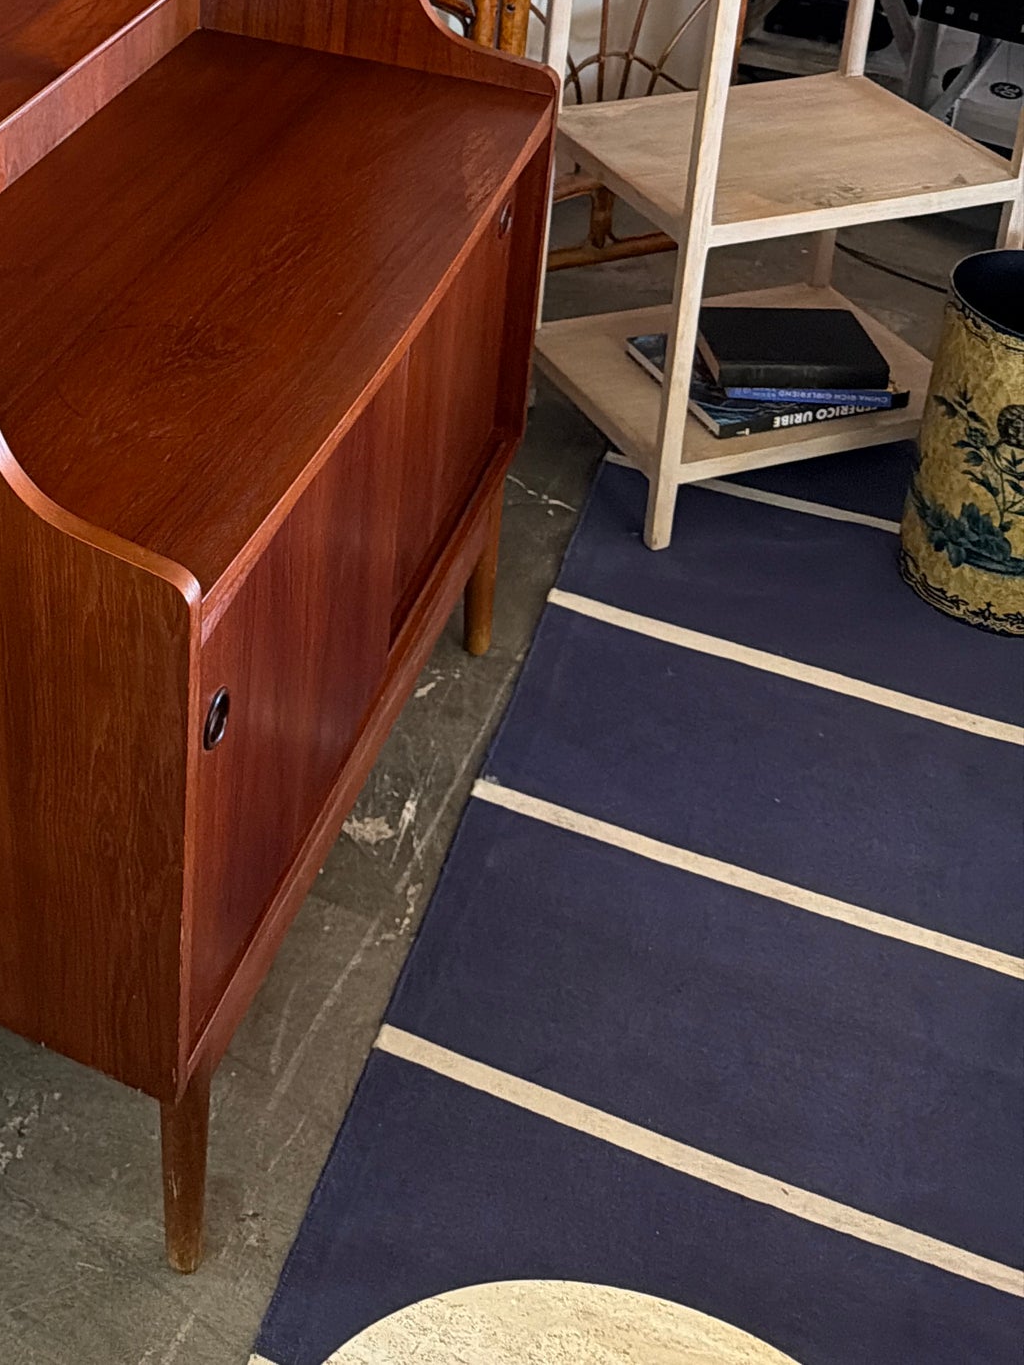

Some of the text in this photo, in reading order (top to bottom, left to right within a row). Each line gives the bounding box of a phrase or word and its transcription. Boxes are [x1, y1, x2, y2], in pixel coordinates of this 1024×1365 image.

[778, 389, 832, 400] GIRLFRIEND
[834, 393, 856, 401] RICH
[772, 410, 813, 428] URIBE
